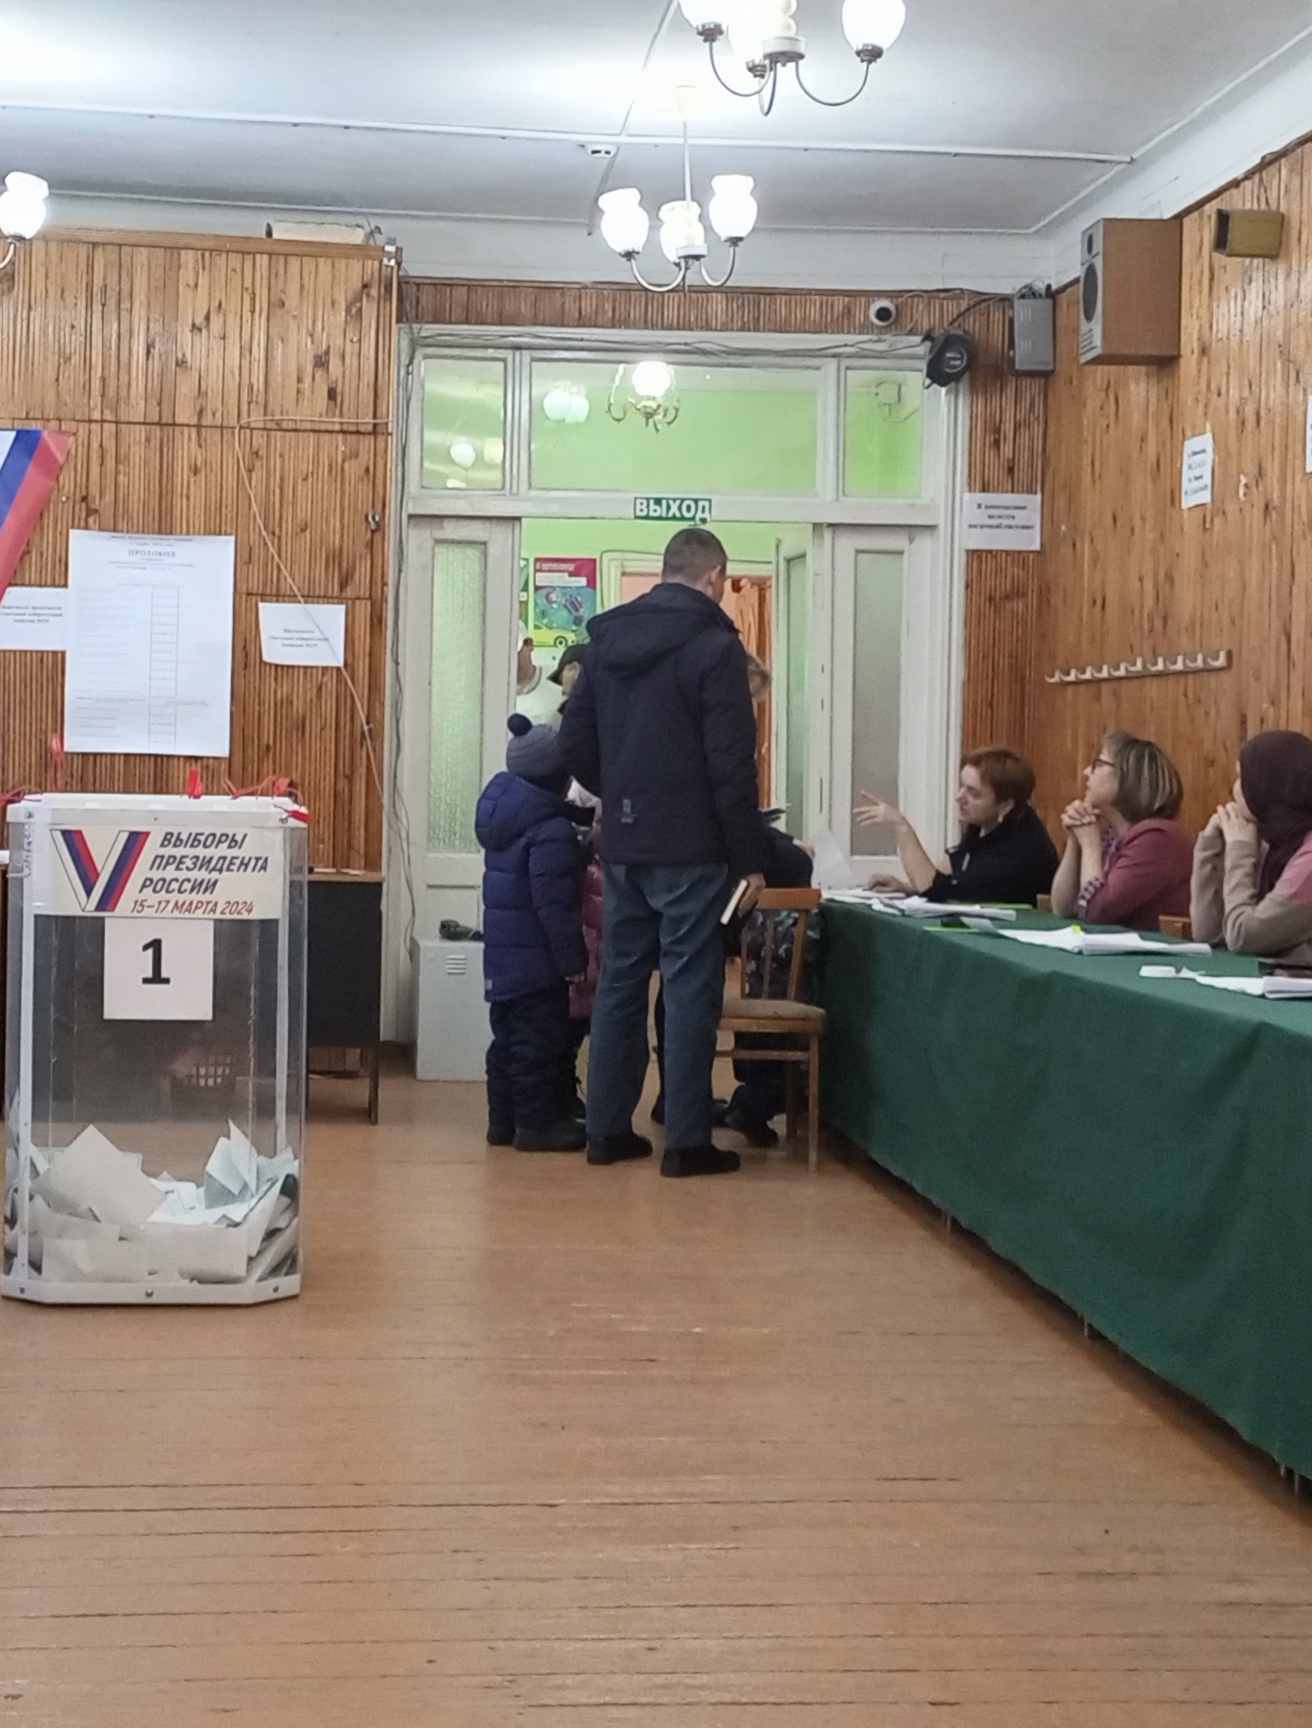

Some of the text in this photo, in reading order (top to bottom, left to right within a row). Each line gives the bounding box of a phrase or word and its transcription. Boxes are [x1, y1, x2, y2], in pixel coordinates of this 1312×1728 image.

[635, 498, 711, 525] ВЫХОД
[159, 831, 248, 850] ВЫБОРЫ
[149, 854, 269, 875] ПРЕЗИДЕНТА
[139, 877, 219, 895] РОССИИ
[171, 899, 218, 915] МАРТА
[220, 900, 254, 916] 2024
[141, 938, 171, 985] 1
